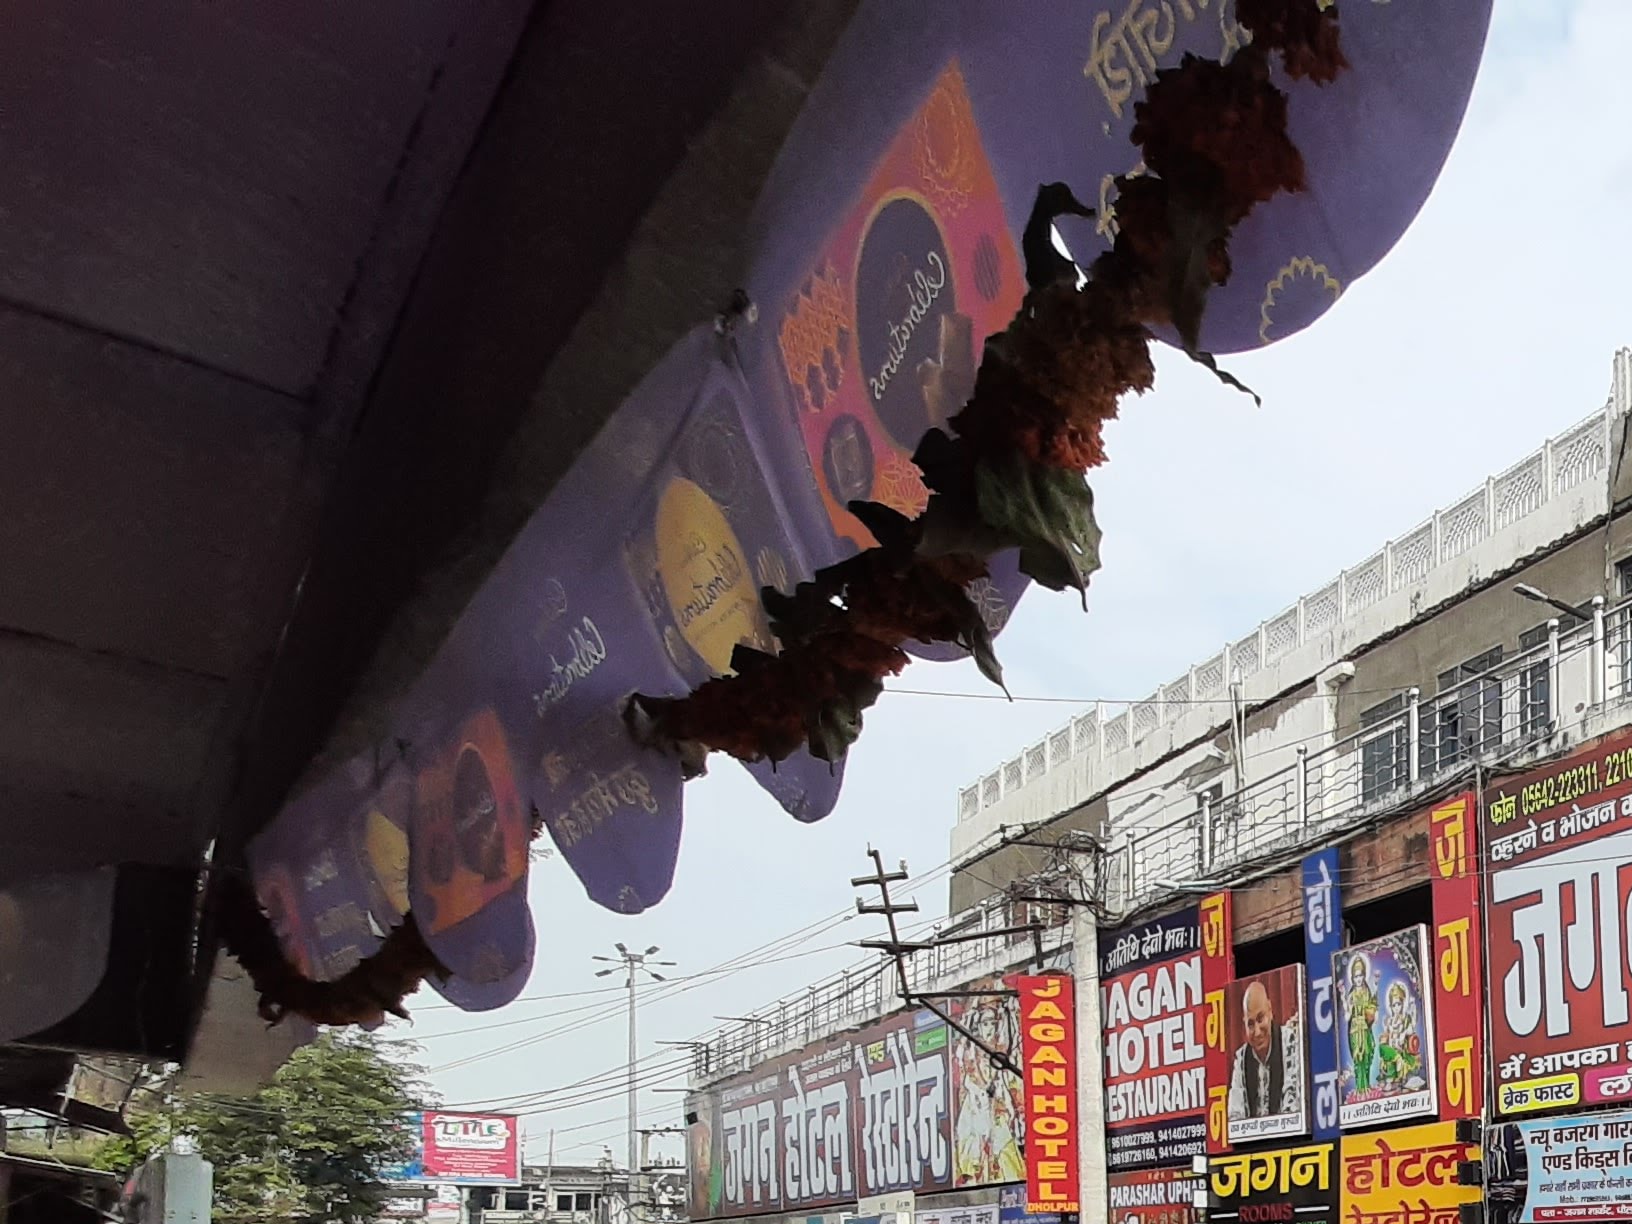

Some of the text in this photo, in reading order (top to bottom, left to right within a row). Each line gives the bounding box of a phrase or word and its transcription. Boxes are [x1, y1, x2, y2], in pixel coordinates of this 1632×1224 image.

[1489, 792, 1517, 825] फोन
[1559, 799, 1618, 837] भोजन
[1105, 933, 1141, 974] अतिथि
[1028, 978, 1068, 1088] JAGAN
[1499, 1054, 1527, 1080] में
[1528, 1041, 1620, 1077] आपका
[1105, 1067, 1206, 1124] ESTAURANT
[1534, 1082, 1575, 1106] फास्ट
[721, 1099, 780, 1204] जगन
[781, 1064, 853, 1201] होटल
[1032, 1094, 1070, 1201] HOTEL
[1208, 1143, 1335, 1198] जगन
[1345, 1138, 1477, 1195] होटल
[1027, 1201, 1079, 1213] DHOLPUR
[1110, 1181, 1166, 1208] PARASHAR
[1238, 1203, 1295, 1222] ROOMS
